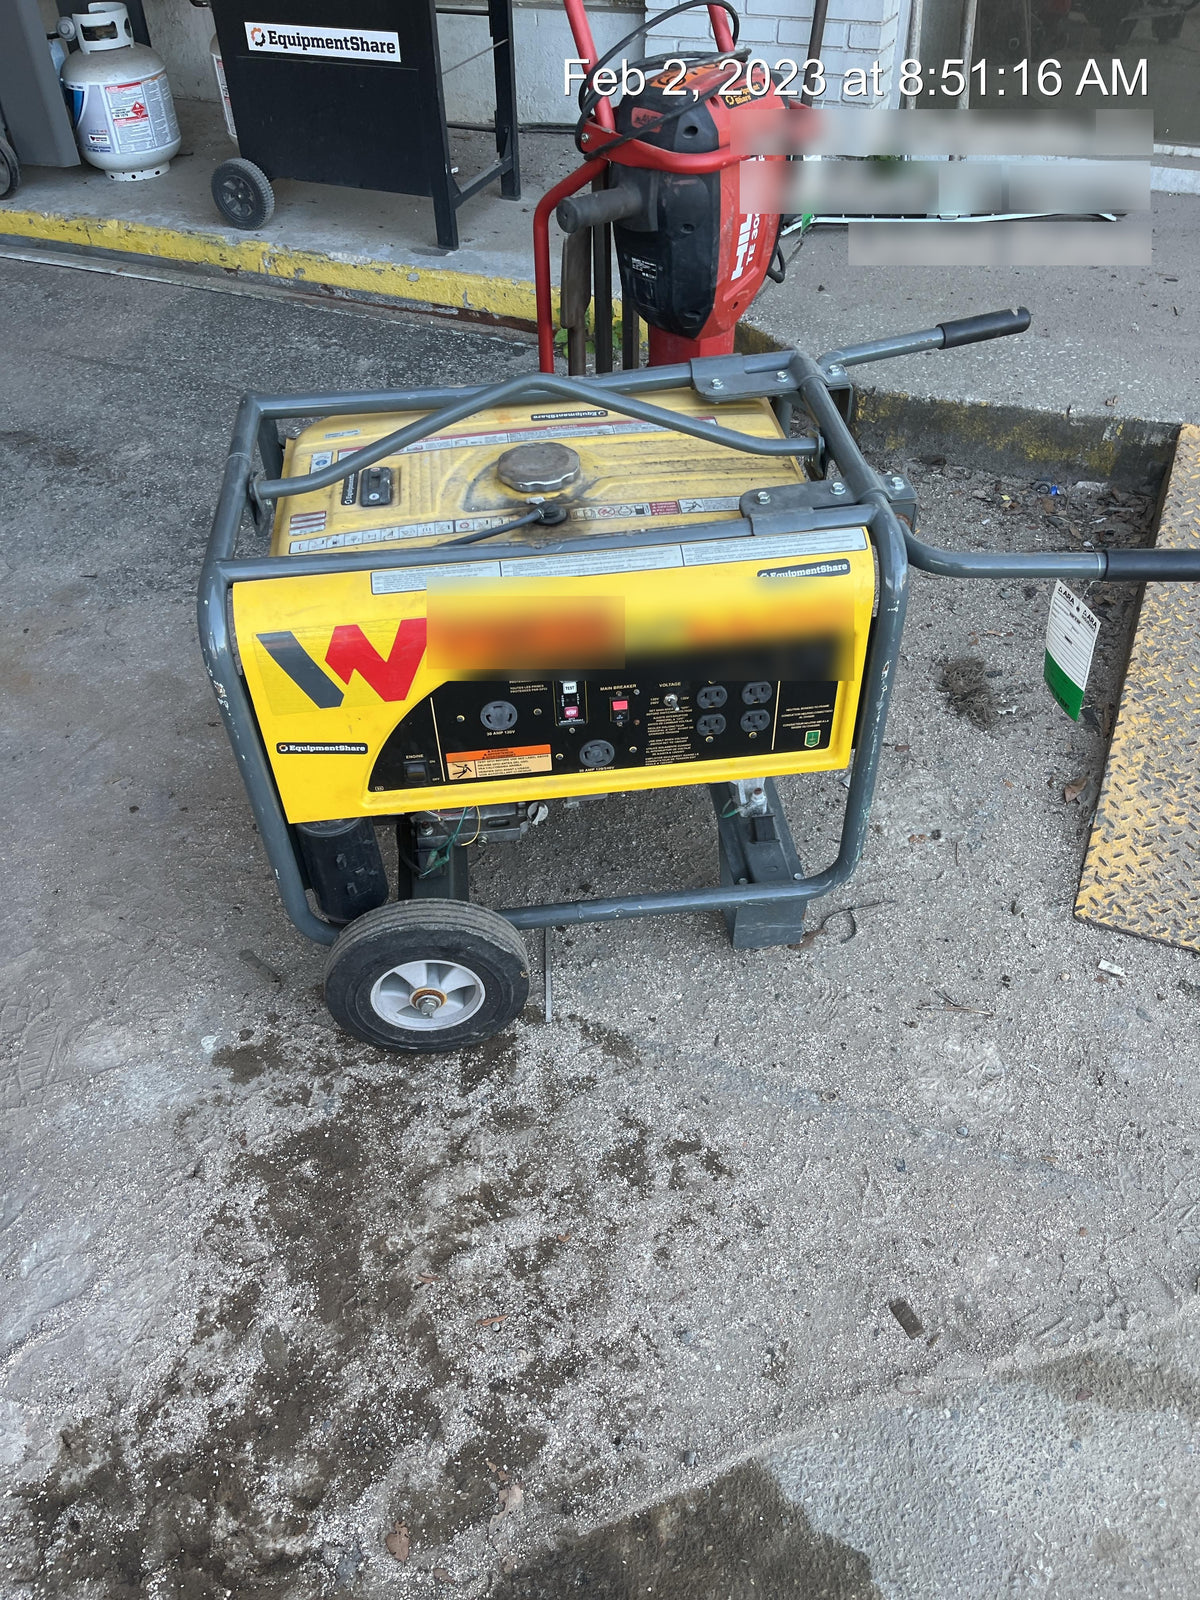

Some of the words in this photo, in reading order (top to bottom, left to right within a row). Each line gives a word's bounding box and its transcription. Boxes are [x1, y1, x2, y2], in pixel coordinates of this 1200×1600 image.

[268, 30, 396, 54] EquipmentShare
[746, 243, 756, 266] TE
[770, 562, 848, 577] EquipmentShare
[289, 744, 366, 753] EquipmentShare
